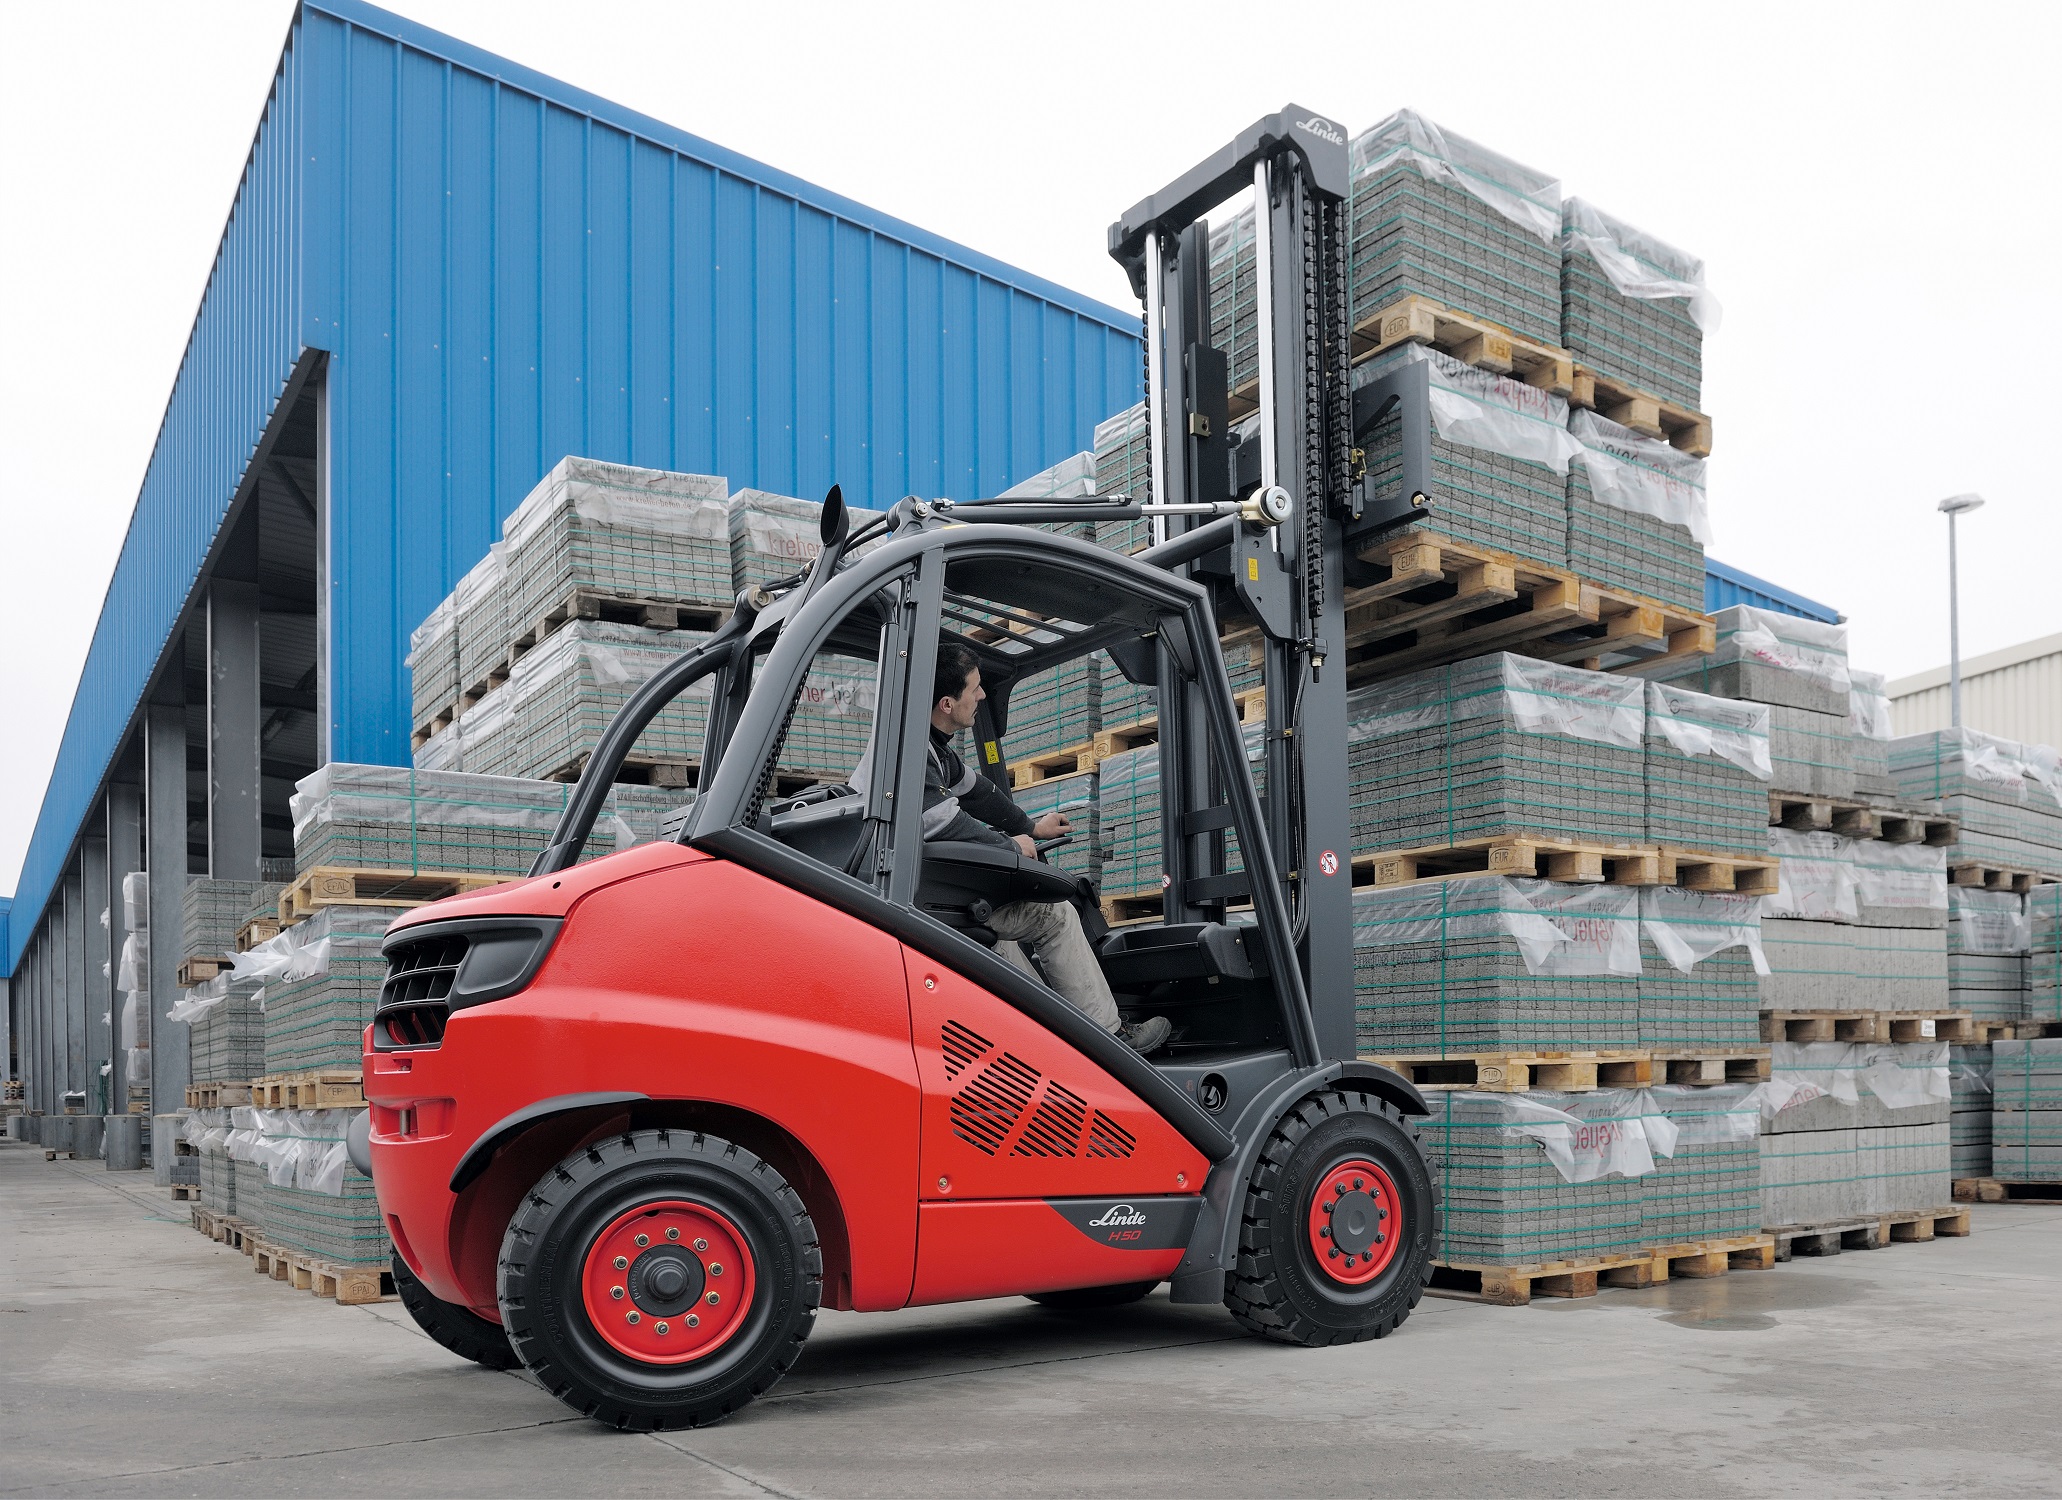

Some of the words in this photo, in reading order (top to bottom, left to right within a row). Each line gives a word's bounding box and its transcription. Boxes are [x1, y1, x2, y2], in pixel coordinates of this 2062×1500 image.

[1296, 116, 1344, 147] Linde
[1389, 319, 1405, 336] EUR
[673, 474, 708, 484] kreativ
[616, 495, 692, 509] www.kreher-beton.de
[768, 530, 821, 557] kreher
[848, 708, 873, 717] kreati
[1494, 851, 1509, 863] EUR
[327, 880, 347, 891] EPAL
[1573, 920, 1613, 953] eher
[1574, 1121, 1622, 1158] reher
[1089, 1204, 1146, 1227] Linde
[1108, 1230, 1143, 1242] H50
